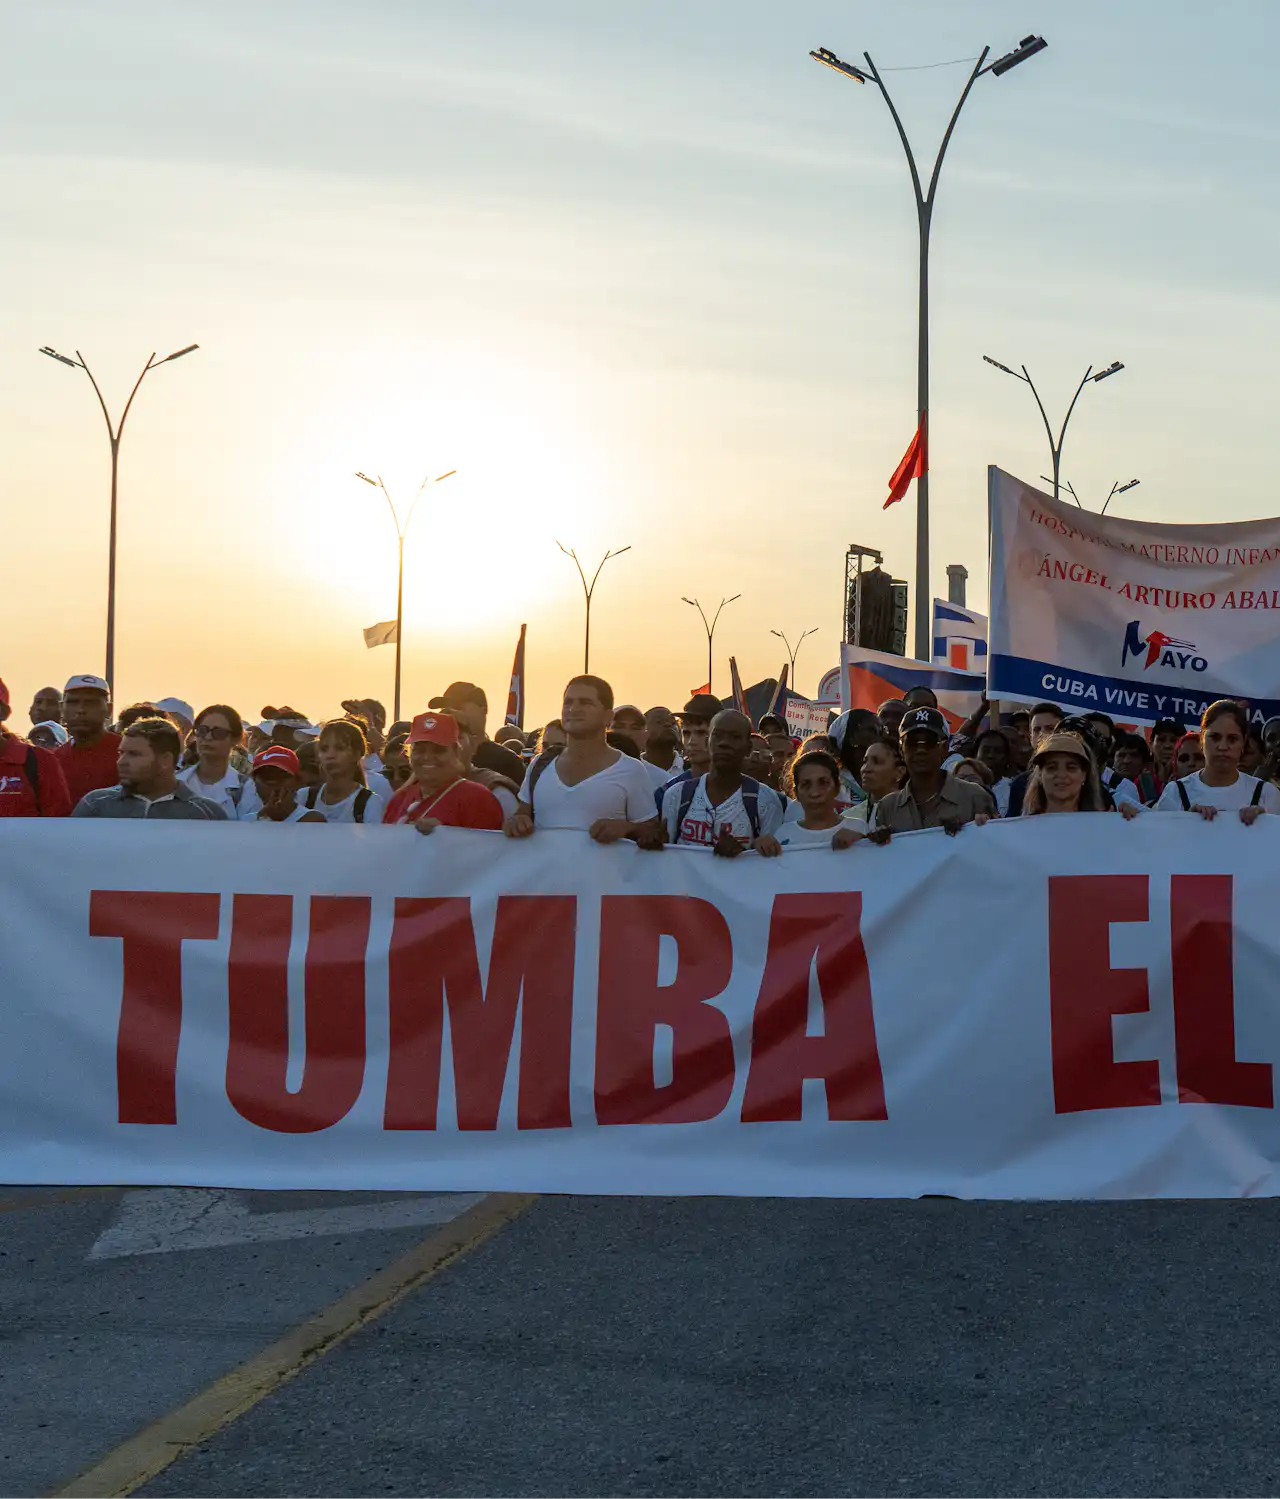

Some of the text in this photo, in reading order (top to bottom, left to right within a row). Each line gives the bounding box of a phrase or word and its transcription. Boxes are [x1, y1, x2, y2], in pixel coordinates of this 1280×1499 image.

[1120, 543, 1219, 566] MATERNO
[1036, 553, 1112, 590] ÁNGEL
[1117, 582, 1216, 610] ARTURO
[1041, 674, 1266, 725] CUBA VIVE Y TRAA
[788, 723, 825, 738] Vam
[90, 890, 886, 1132] TUMBA
[1050, 875, 1273, 1113] EL
